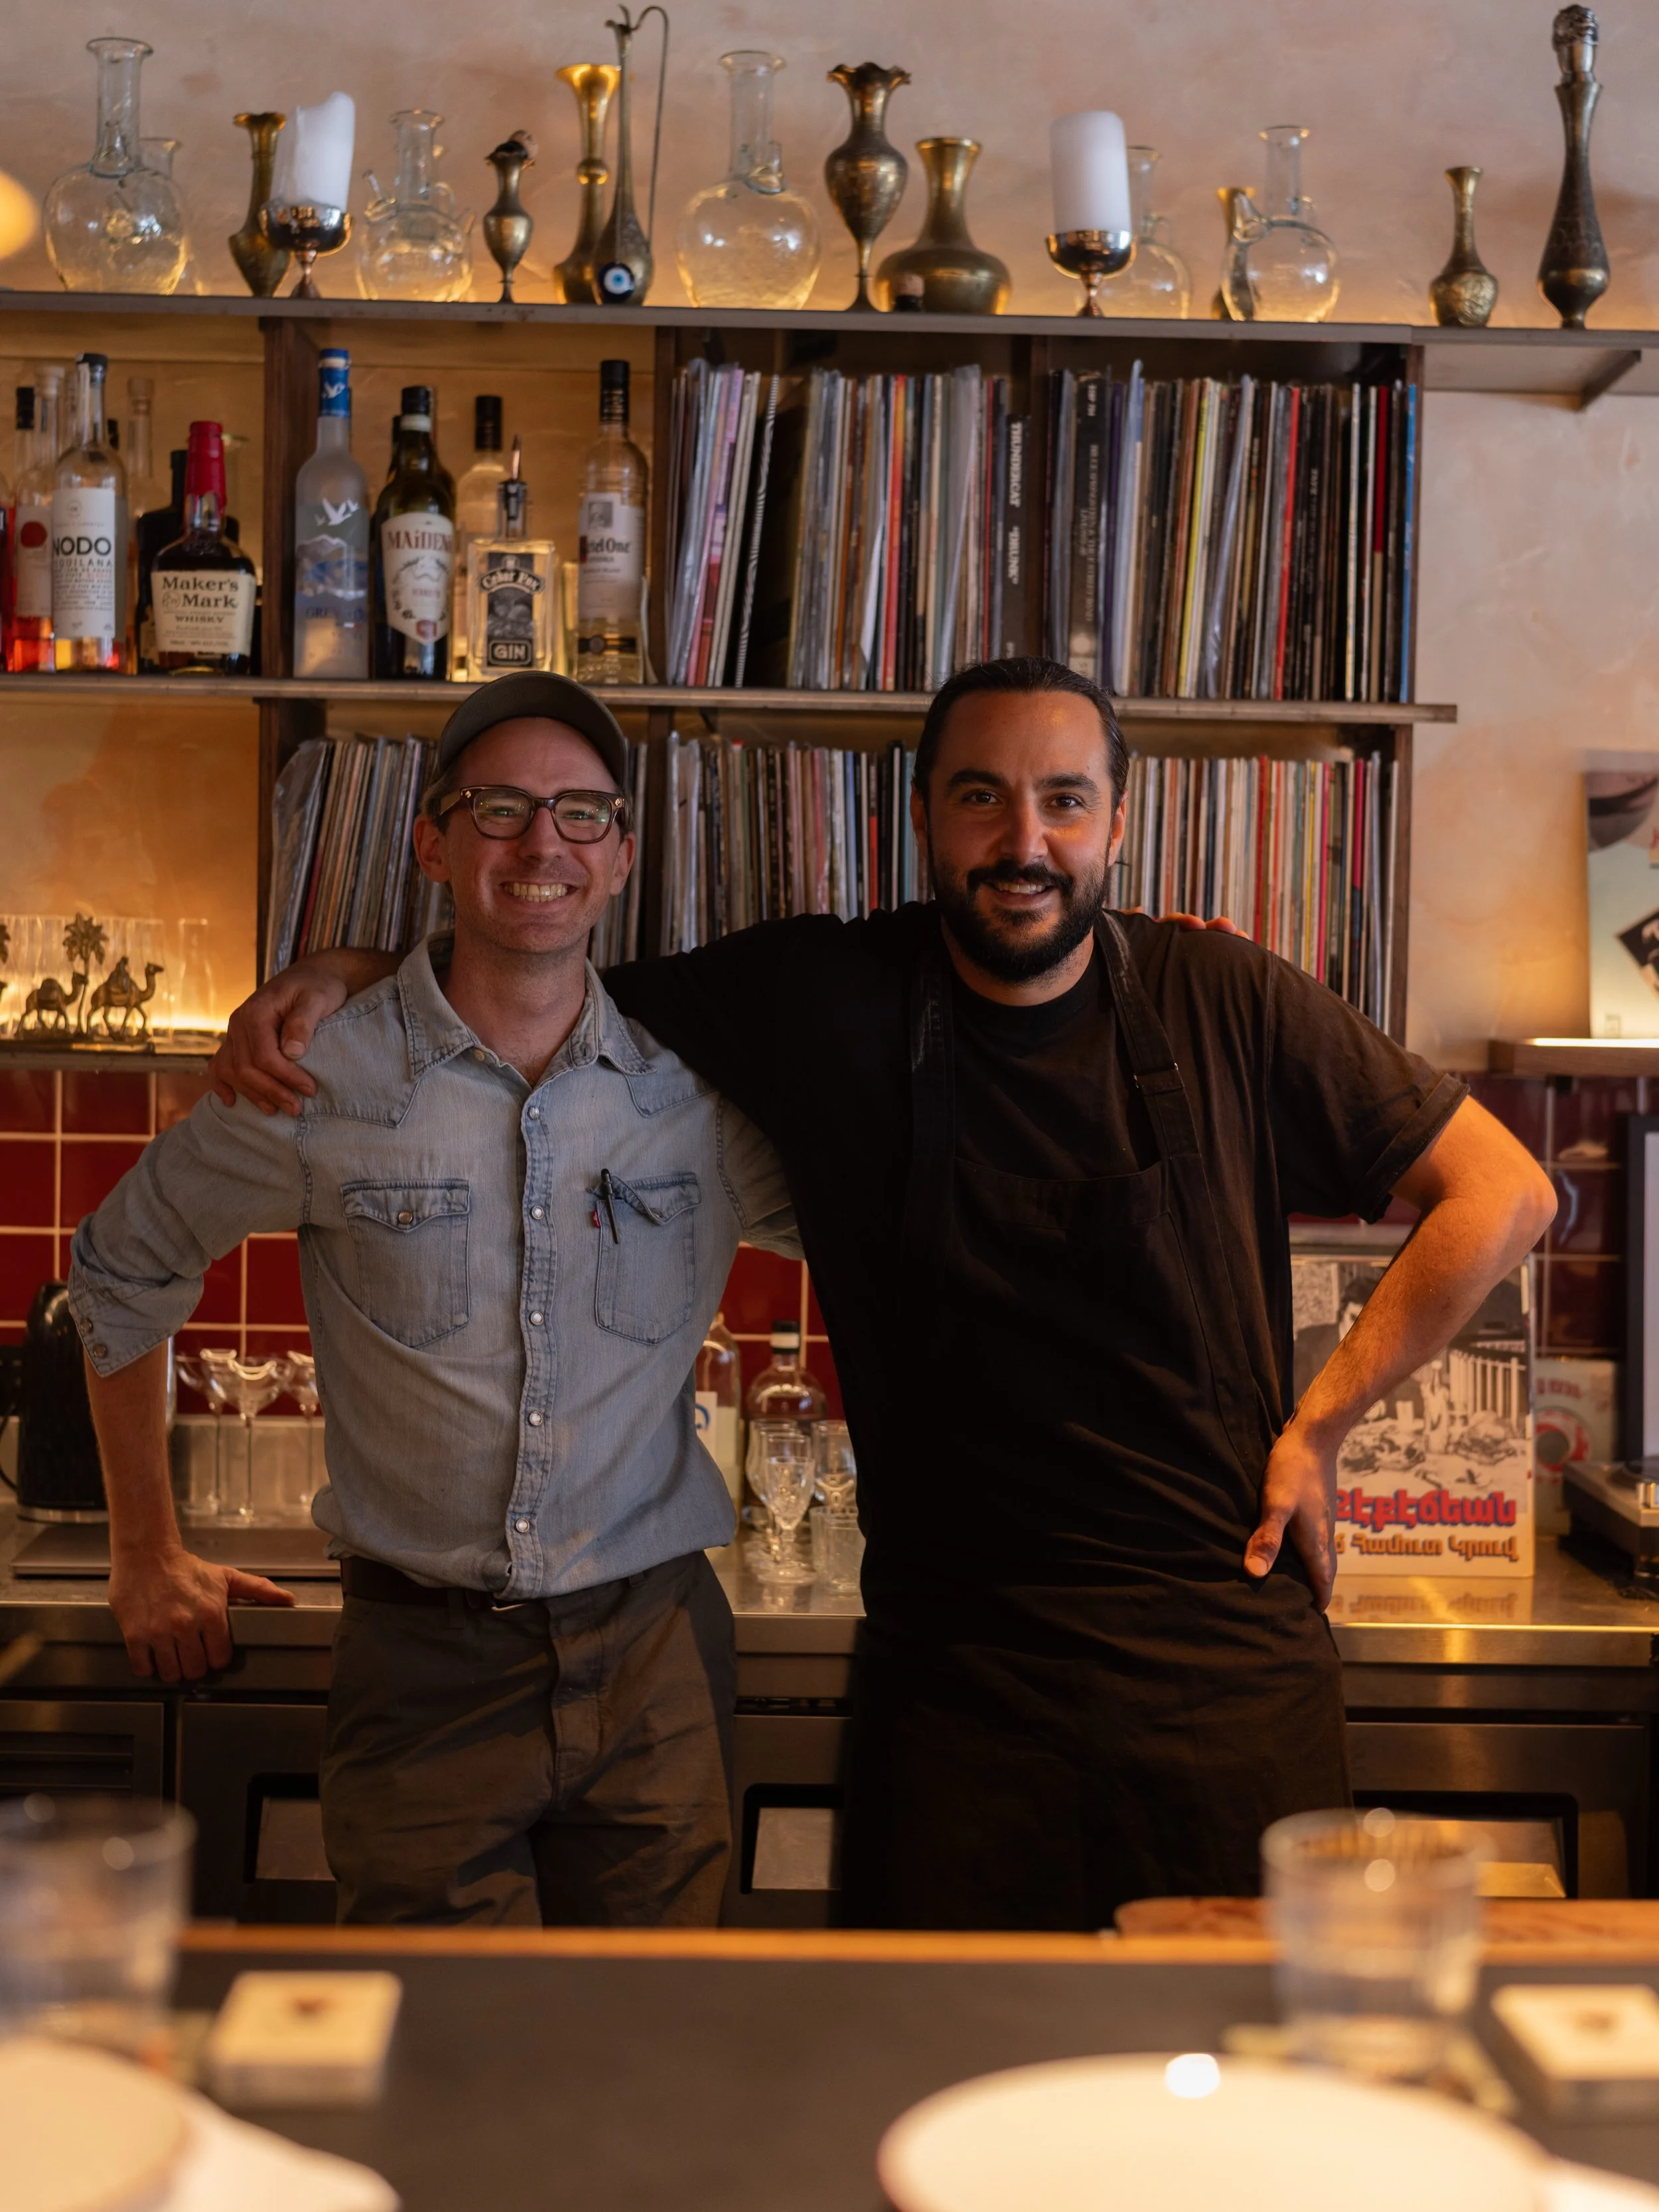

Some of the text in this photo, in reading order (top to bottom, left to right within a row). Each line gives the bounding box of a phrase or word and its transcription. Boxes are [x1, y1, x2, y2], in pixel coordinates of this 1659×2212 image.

[1009, 421, 1023, 508] THUNDERCAT
[162, 577, 238, 591] Maker's
[182, 593, 238, 609] Mark
[494, 644, 526, 660] GIN
